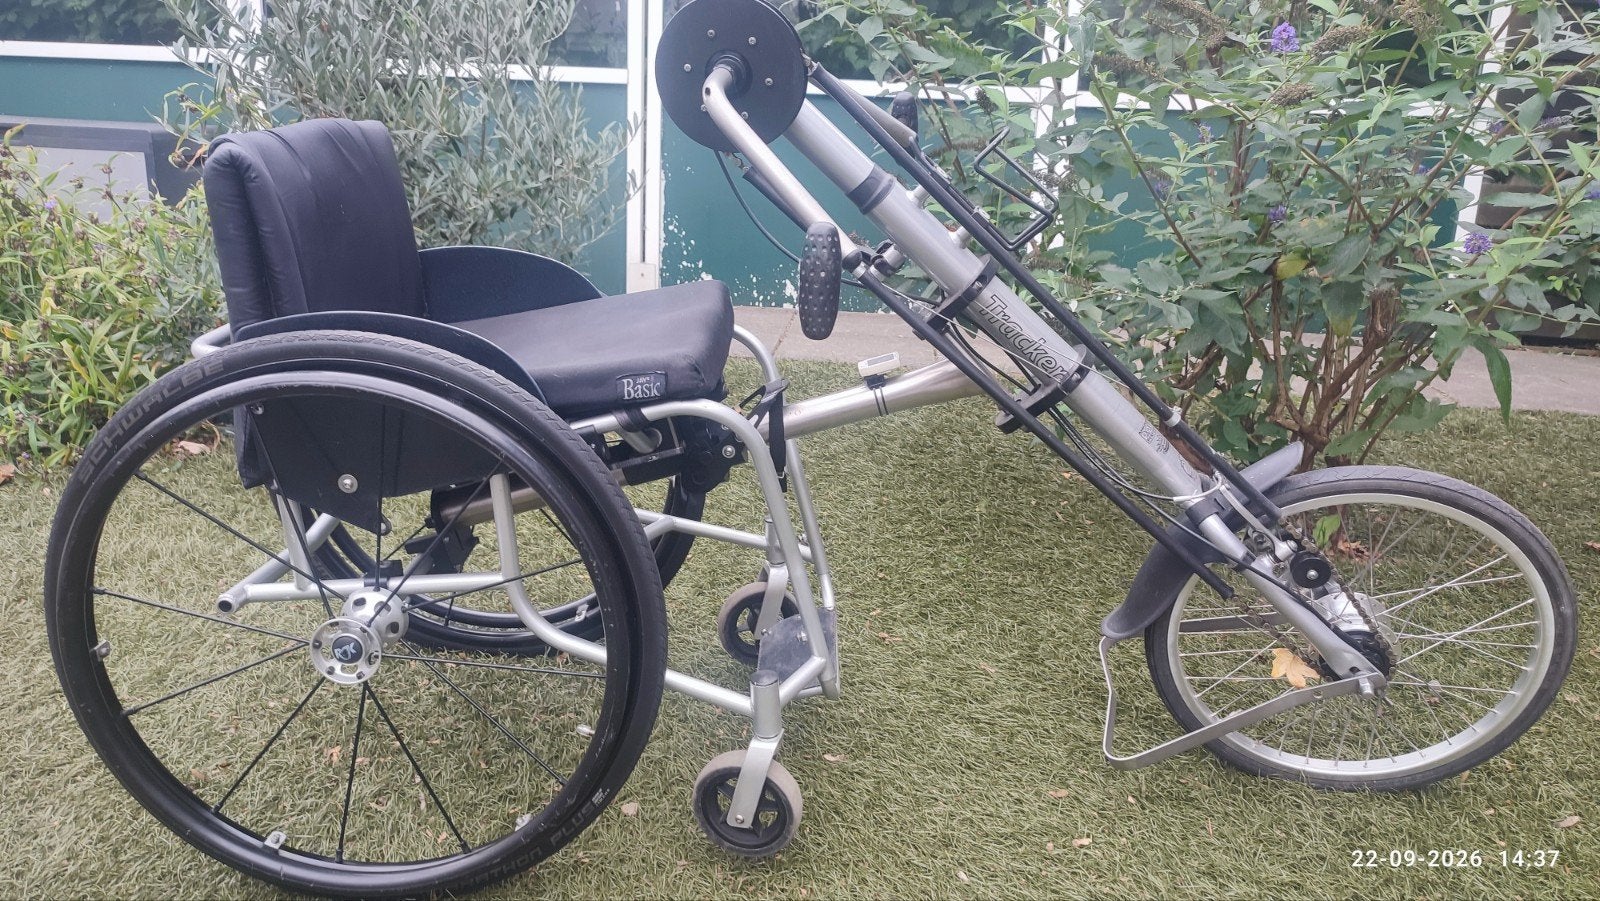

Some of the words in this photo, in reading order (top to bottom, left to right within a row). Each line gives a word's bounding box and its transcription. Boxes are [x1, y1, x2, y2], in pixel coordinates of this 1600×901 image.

[979, 293, 1070, 382] Tracker
[78, 358, 226, 485] SCHWALBE
[621, 378, 661, 400] Basic
[551, 801, 596, 847] PLUS
